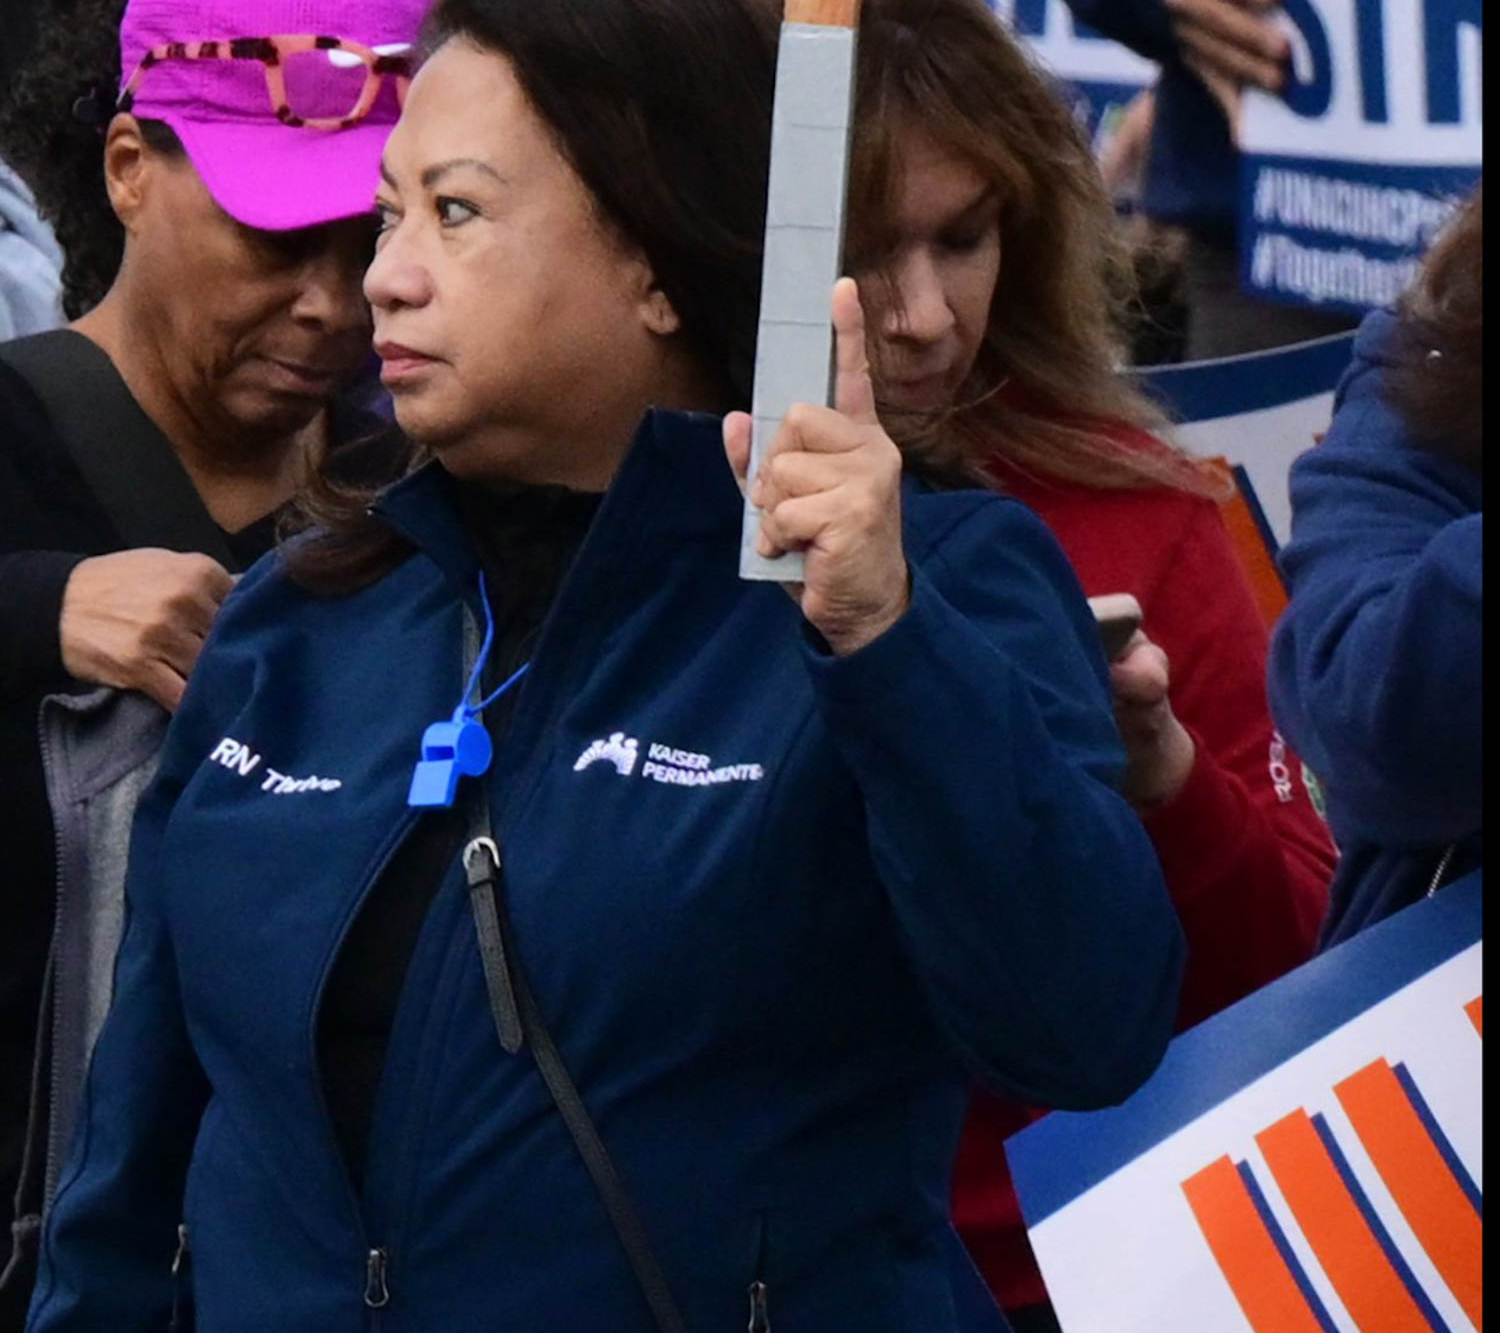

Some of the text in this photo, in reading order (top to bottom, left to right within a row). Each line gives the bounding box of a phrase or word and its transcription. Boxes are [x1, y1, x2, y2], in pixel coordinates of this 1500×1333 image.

[210, 737, 261, 776] RN
[648, 743, 711, 769] KAISER
[642, 761, 764, 787] PERMANENTE
